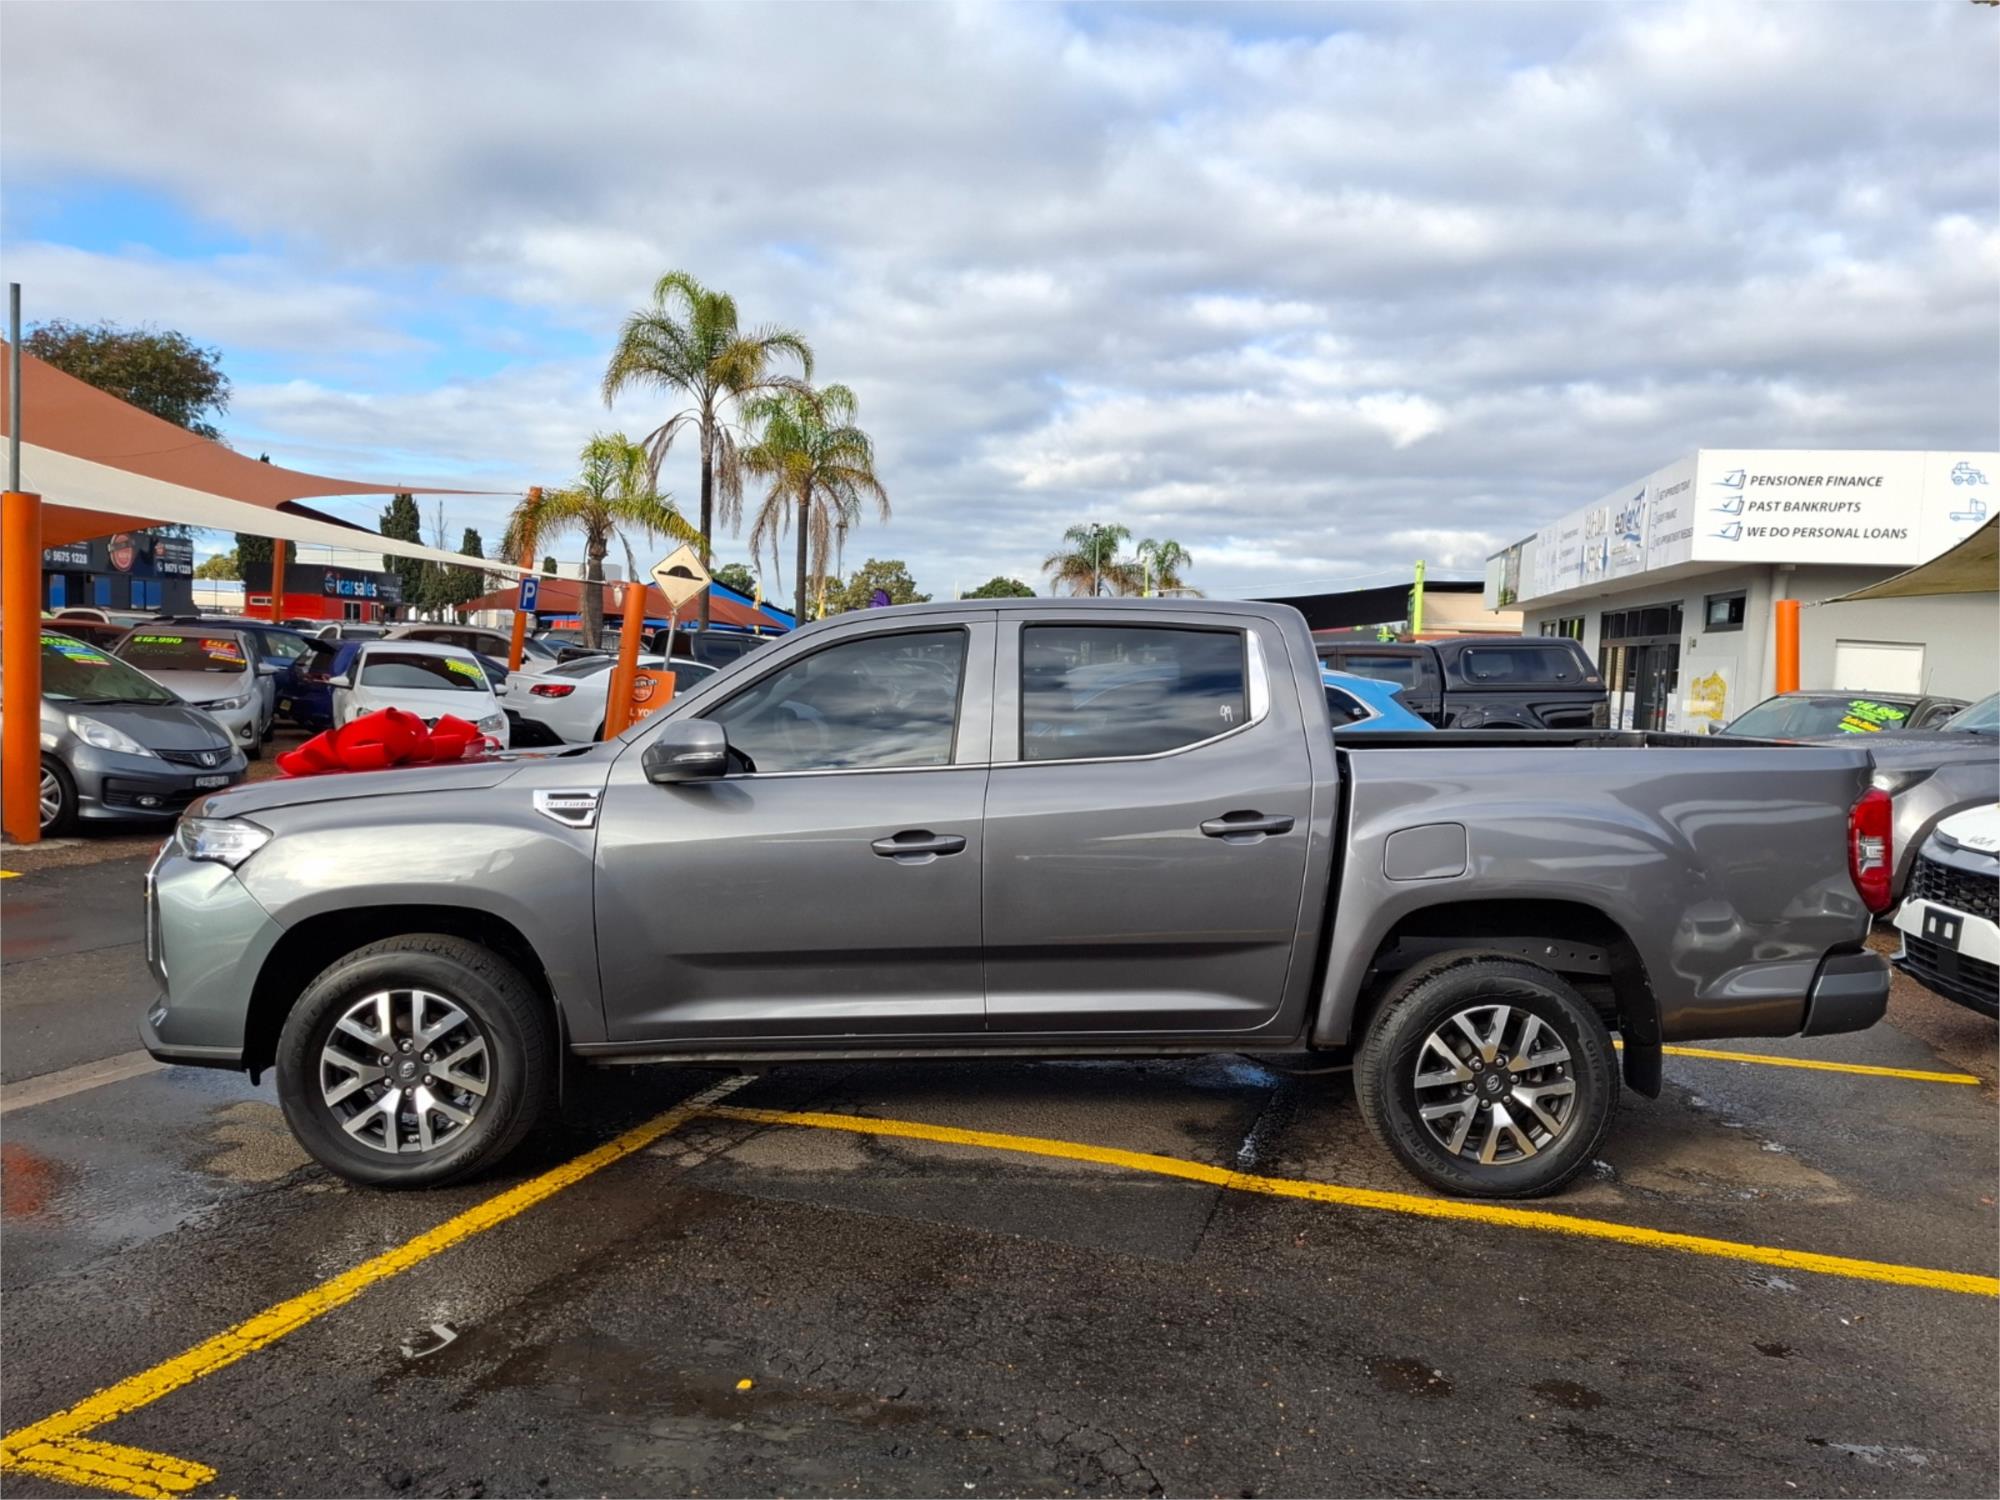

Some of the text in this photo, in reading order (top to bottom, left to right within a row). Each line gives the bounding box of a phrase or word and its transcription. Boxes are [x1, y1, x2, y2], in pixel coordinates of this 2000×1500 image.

[1750, 475, 1883, 487] PENSIONER FINANCE
[1748, 501, 1861, 513] PAST BANKRUPTS
[1747, 527, 1908, 540] WE DO PERSONAL LOANS
[336, 574, 377, 597] icarsales
[523, 581, 536, 607] P
